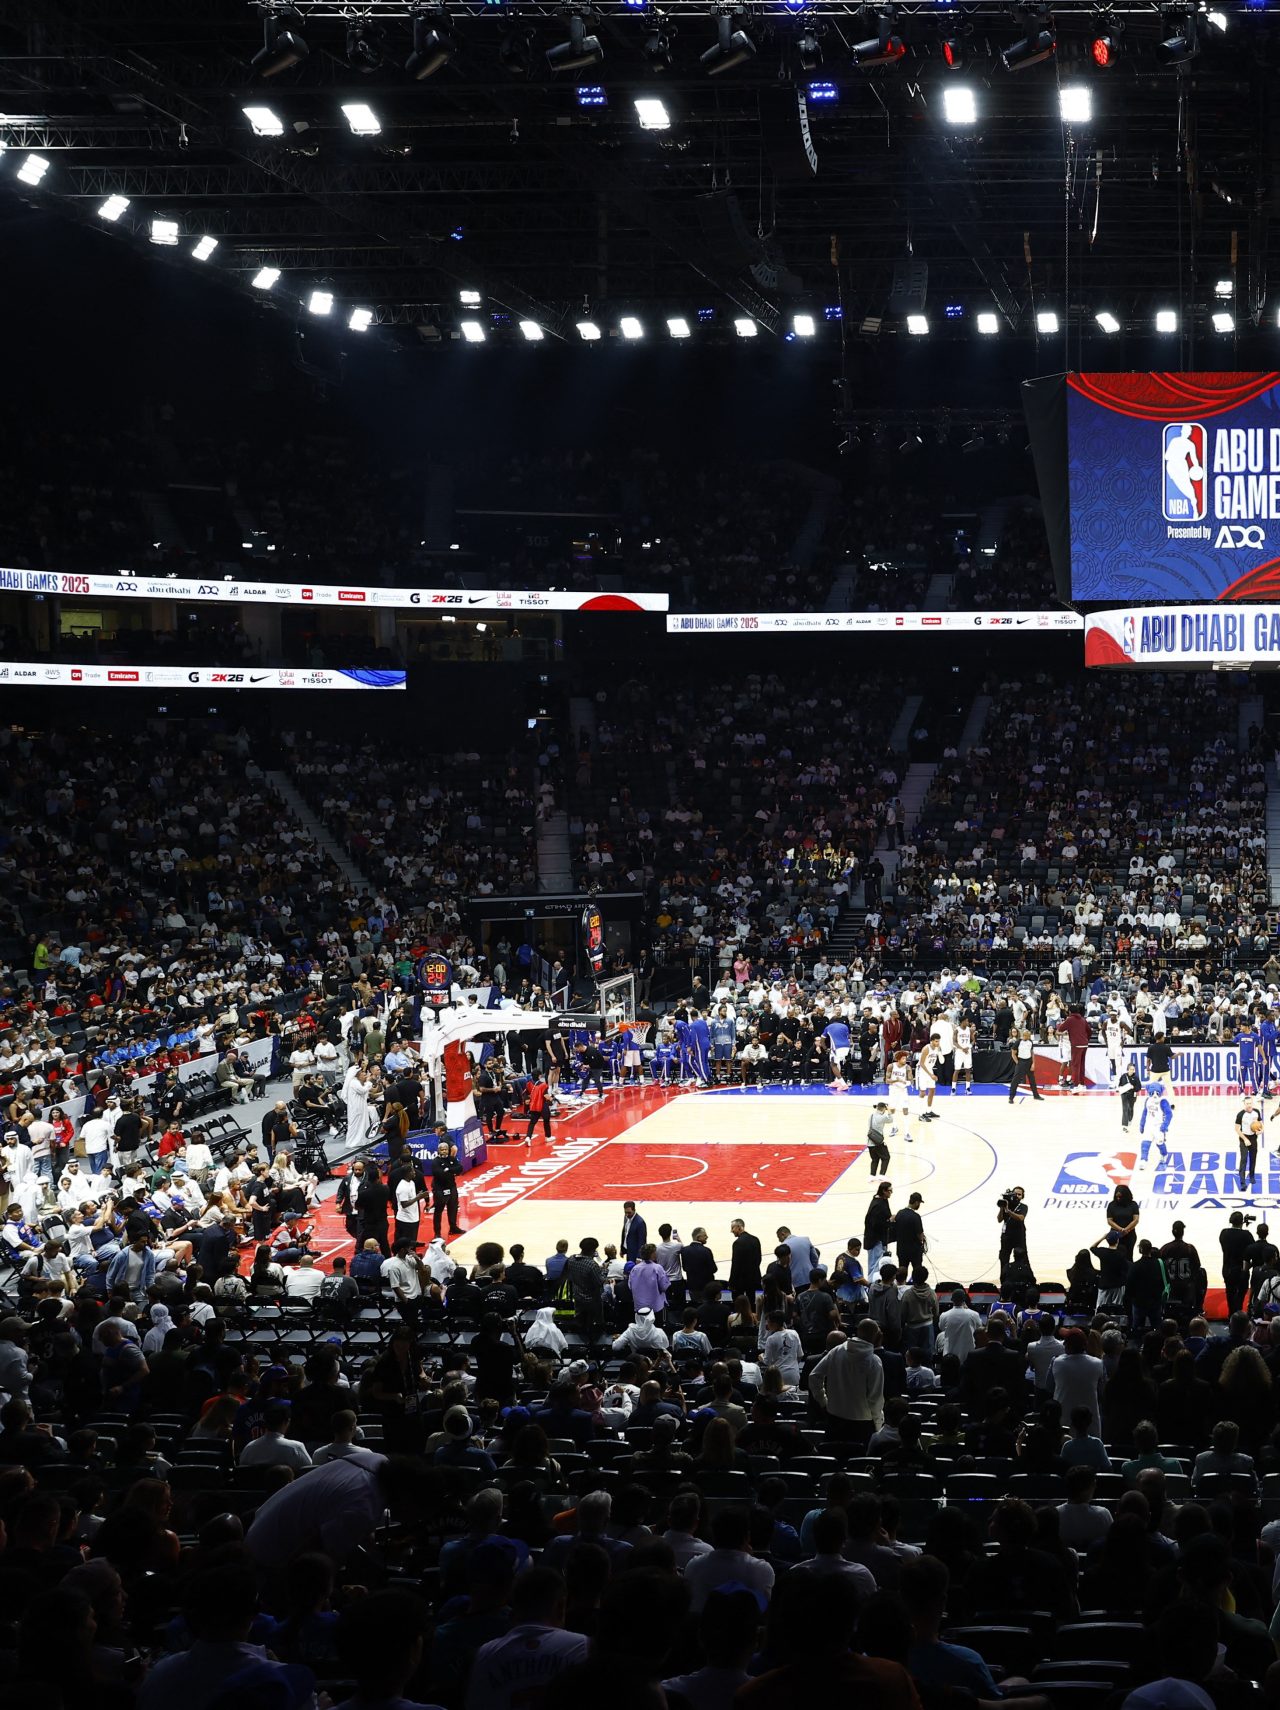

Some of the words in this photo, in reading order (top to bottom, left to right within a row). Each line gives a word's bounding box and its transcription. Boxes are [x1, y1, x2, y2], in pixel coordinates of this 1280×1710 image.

[1213, 428, 1265, 473] ABU
[1169, 501, 1189, 515] NBA
[1167, 525, 1197, 539] Presented
[1199, 527, 1211, 541] by
[1214, 526, 1265, 549] ADQ
[26, 572, 58, 591] GAMES
[62, 576, 90, 593] 2025
[432, 595, 463, 603] 2K26
[680, 617, 694, 629] ABU
[695, 617, 715, 629] DHABI
[716, 617, 738, 629] GAMES
[740, 617, 758, 628] 2025
[1140, 614, 1176, 653] ABU
[1181, 613, 1245, 653] DHABI
[211, 674, 244, 682] 2K26
[427, 973, 443, 984] 24
[518, 1137, 608, 1176] dhabi
[1154, 1151, 1252, 1172] ABU
[470, 1177, 545, 1207] abu
[1060, 1184, 1100, 1194] NBA
